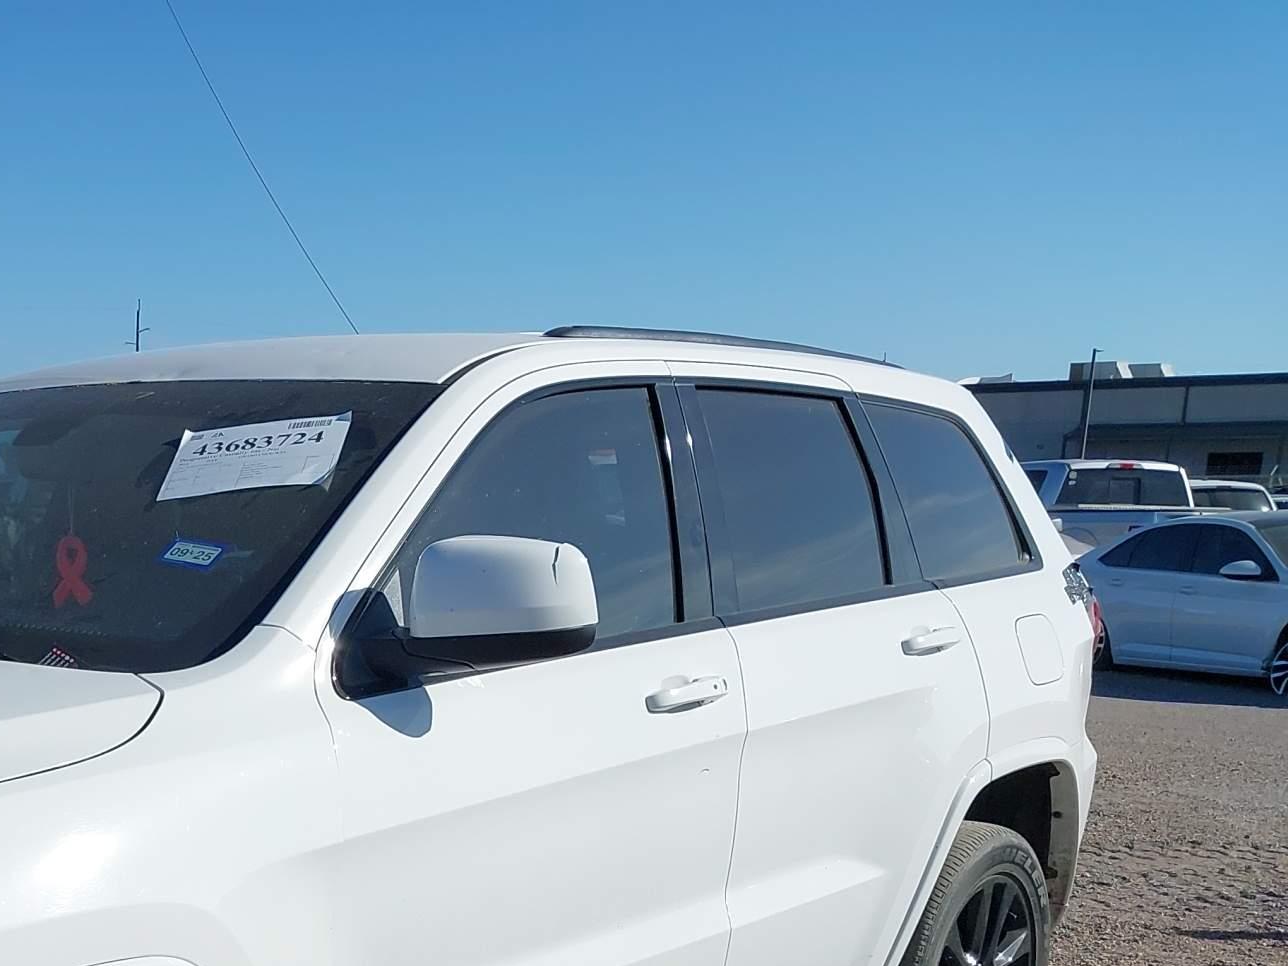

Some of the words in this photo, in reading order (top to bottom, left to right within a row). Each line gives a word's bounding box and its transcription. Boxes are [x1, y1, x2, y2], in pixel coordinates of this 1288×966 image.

[192, 430, 325, 457] 43683724
[169, 547, 190, 558] 09
[193, 550, 216, 561] 25
